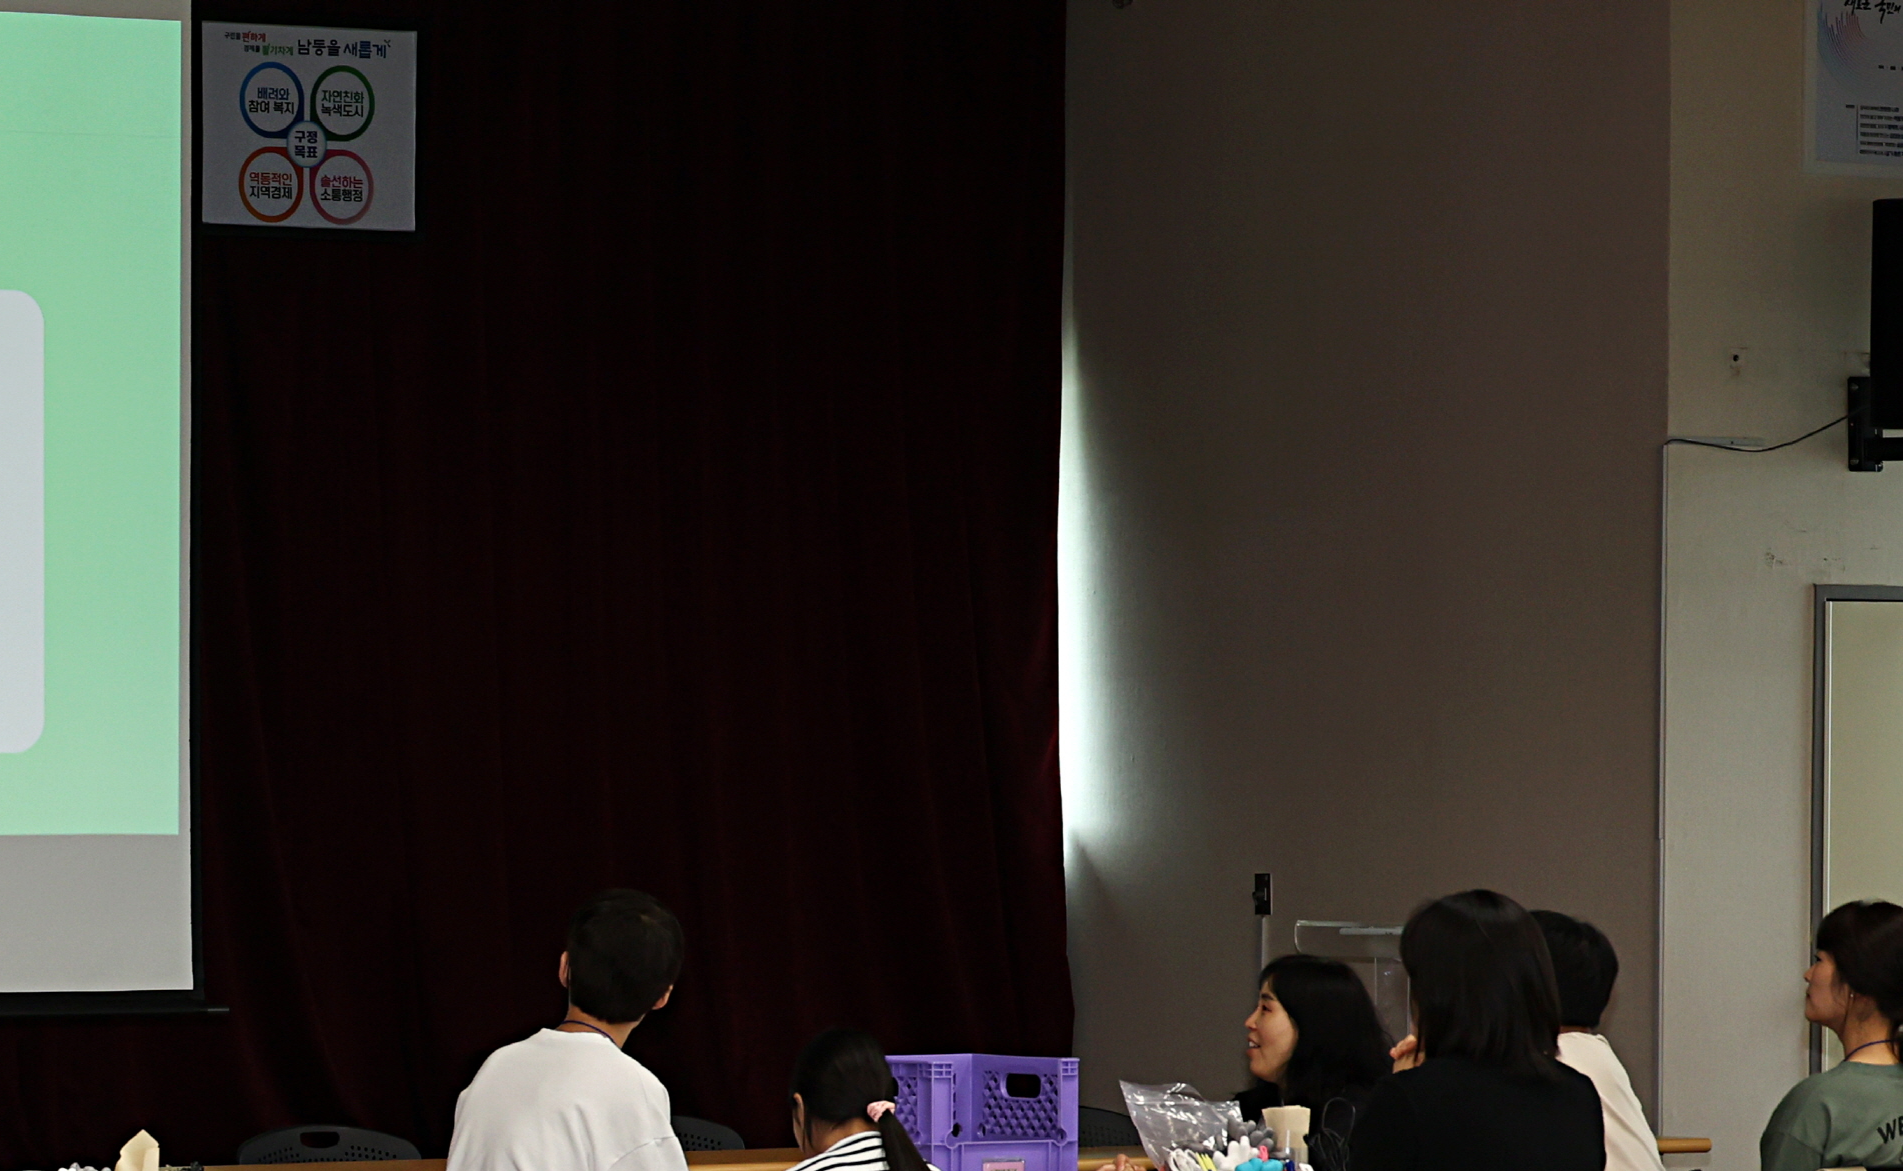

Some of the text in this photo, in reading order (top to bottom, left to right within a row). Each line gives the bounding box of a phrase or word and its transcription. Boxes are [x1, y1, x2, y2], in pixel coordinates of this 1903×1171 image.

[343, 41, 387, 59] 새롭게
[257, 86, 290, 101] 배려와
[321, 89, 364, 104] 자연친화
[248, 100, 295, 115] 참여 복지
[321, 104, 364, 118] 녹색도시
[294, 131, 318, 144] 구정
[294, 146, 318, 159] 목표
[249, 171, 292, 186] 역동적인
[249, 186, 292, 200] 지역경제
[320, 189, 364, 202] 소통행정
